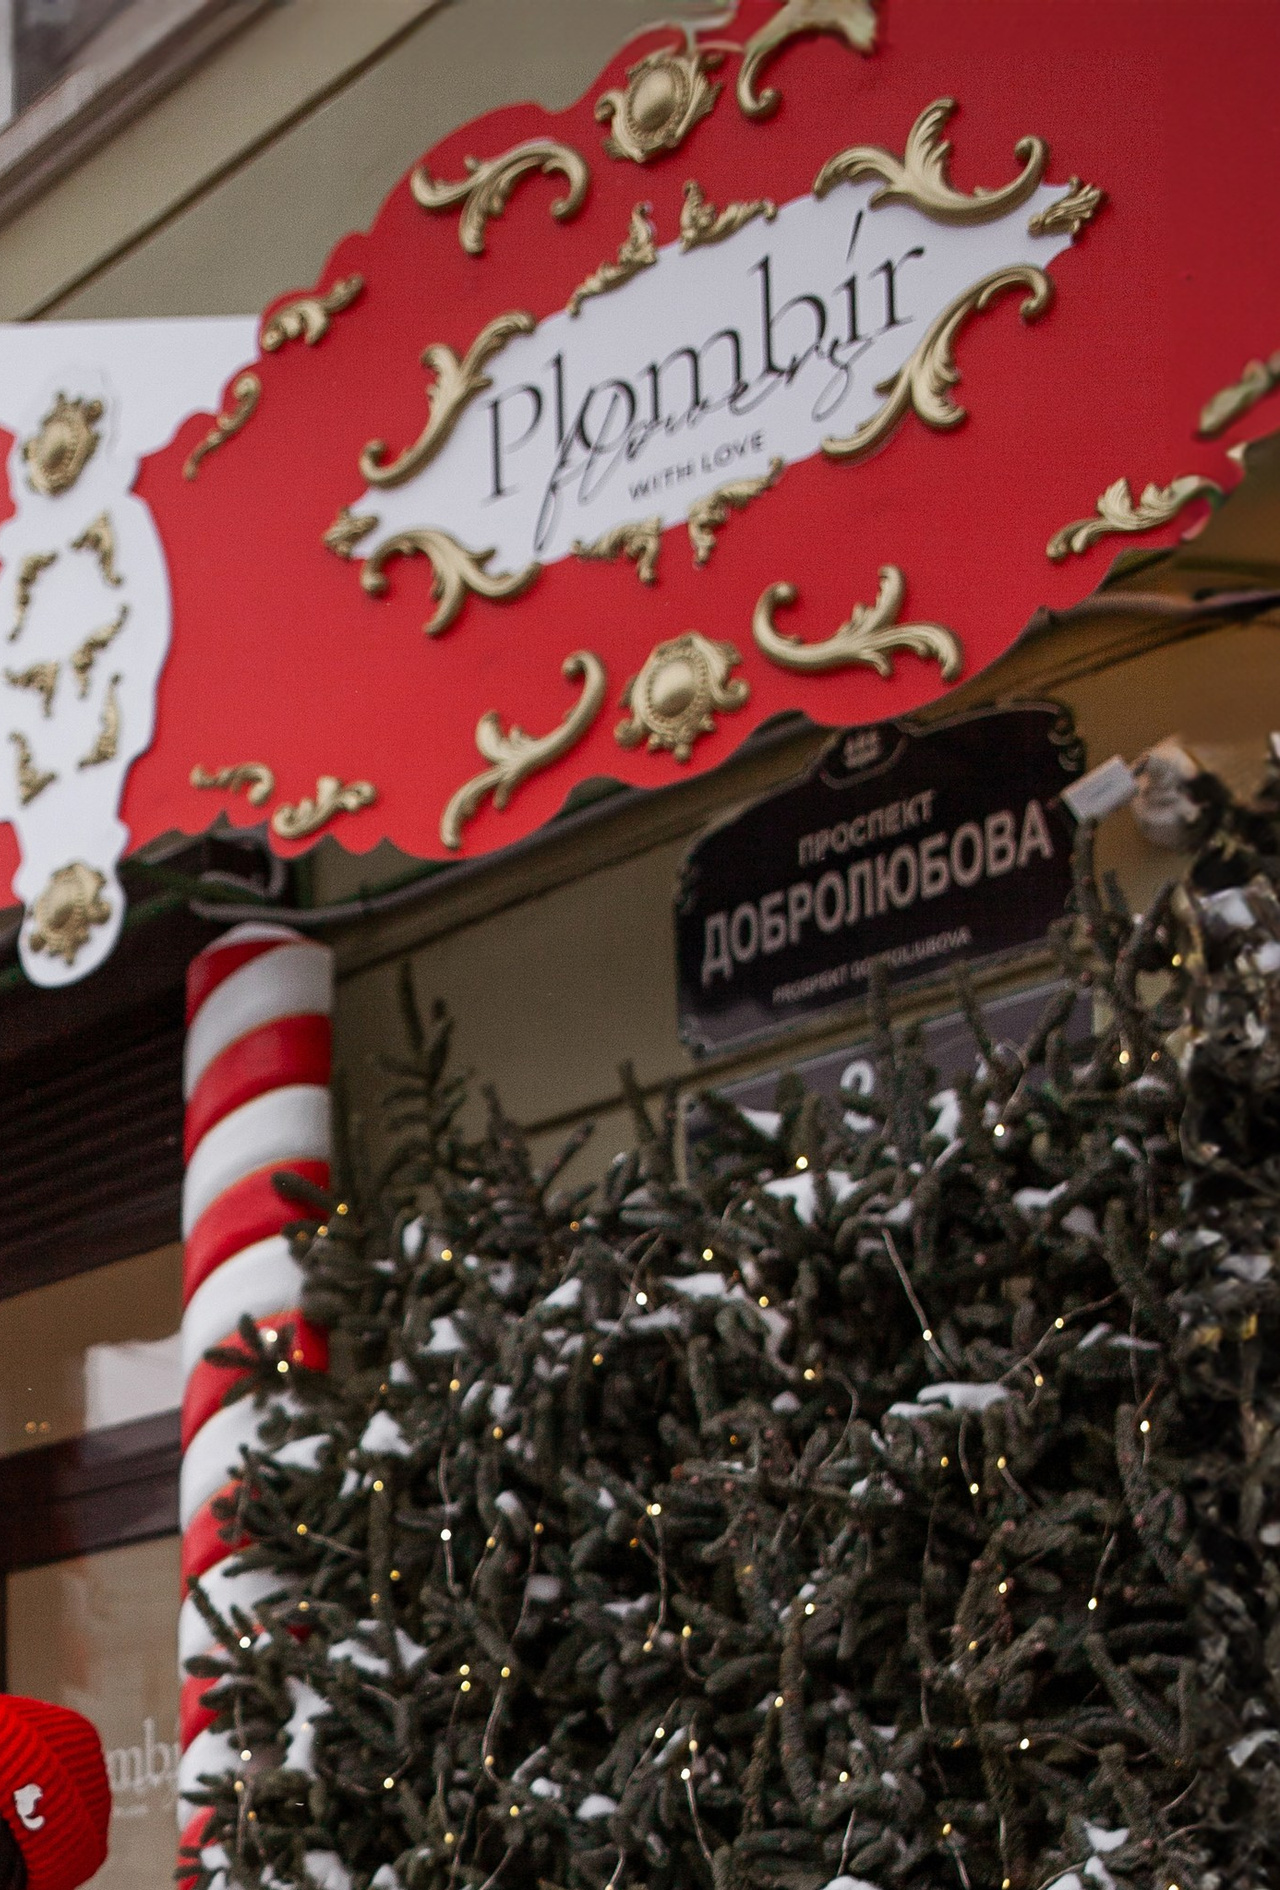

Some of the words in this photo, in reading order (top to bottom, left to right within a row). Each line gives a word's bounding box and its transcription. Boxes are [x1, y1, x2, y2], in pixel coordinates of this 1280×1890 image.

[628, 459, 696, 501] WITH
[700, 429, 766, 475] LOVE
[797, 788, 937, 868] ПРОСПЕКТ
[701, 799, 1056, 986] ДОБРОЛЮБОВА
